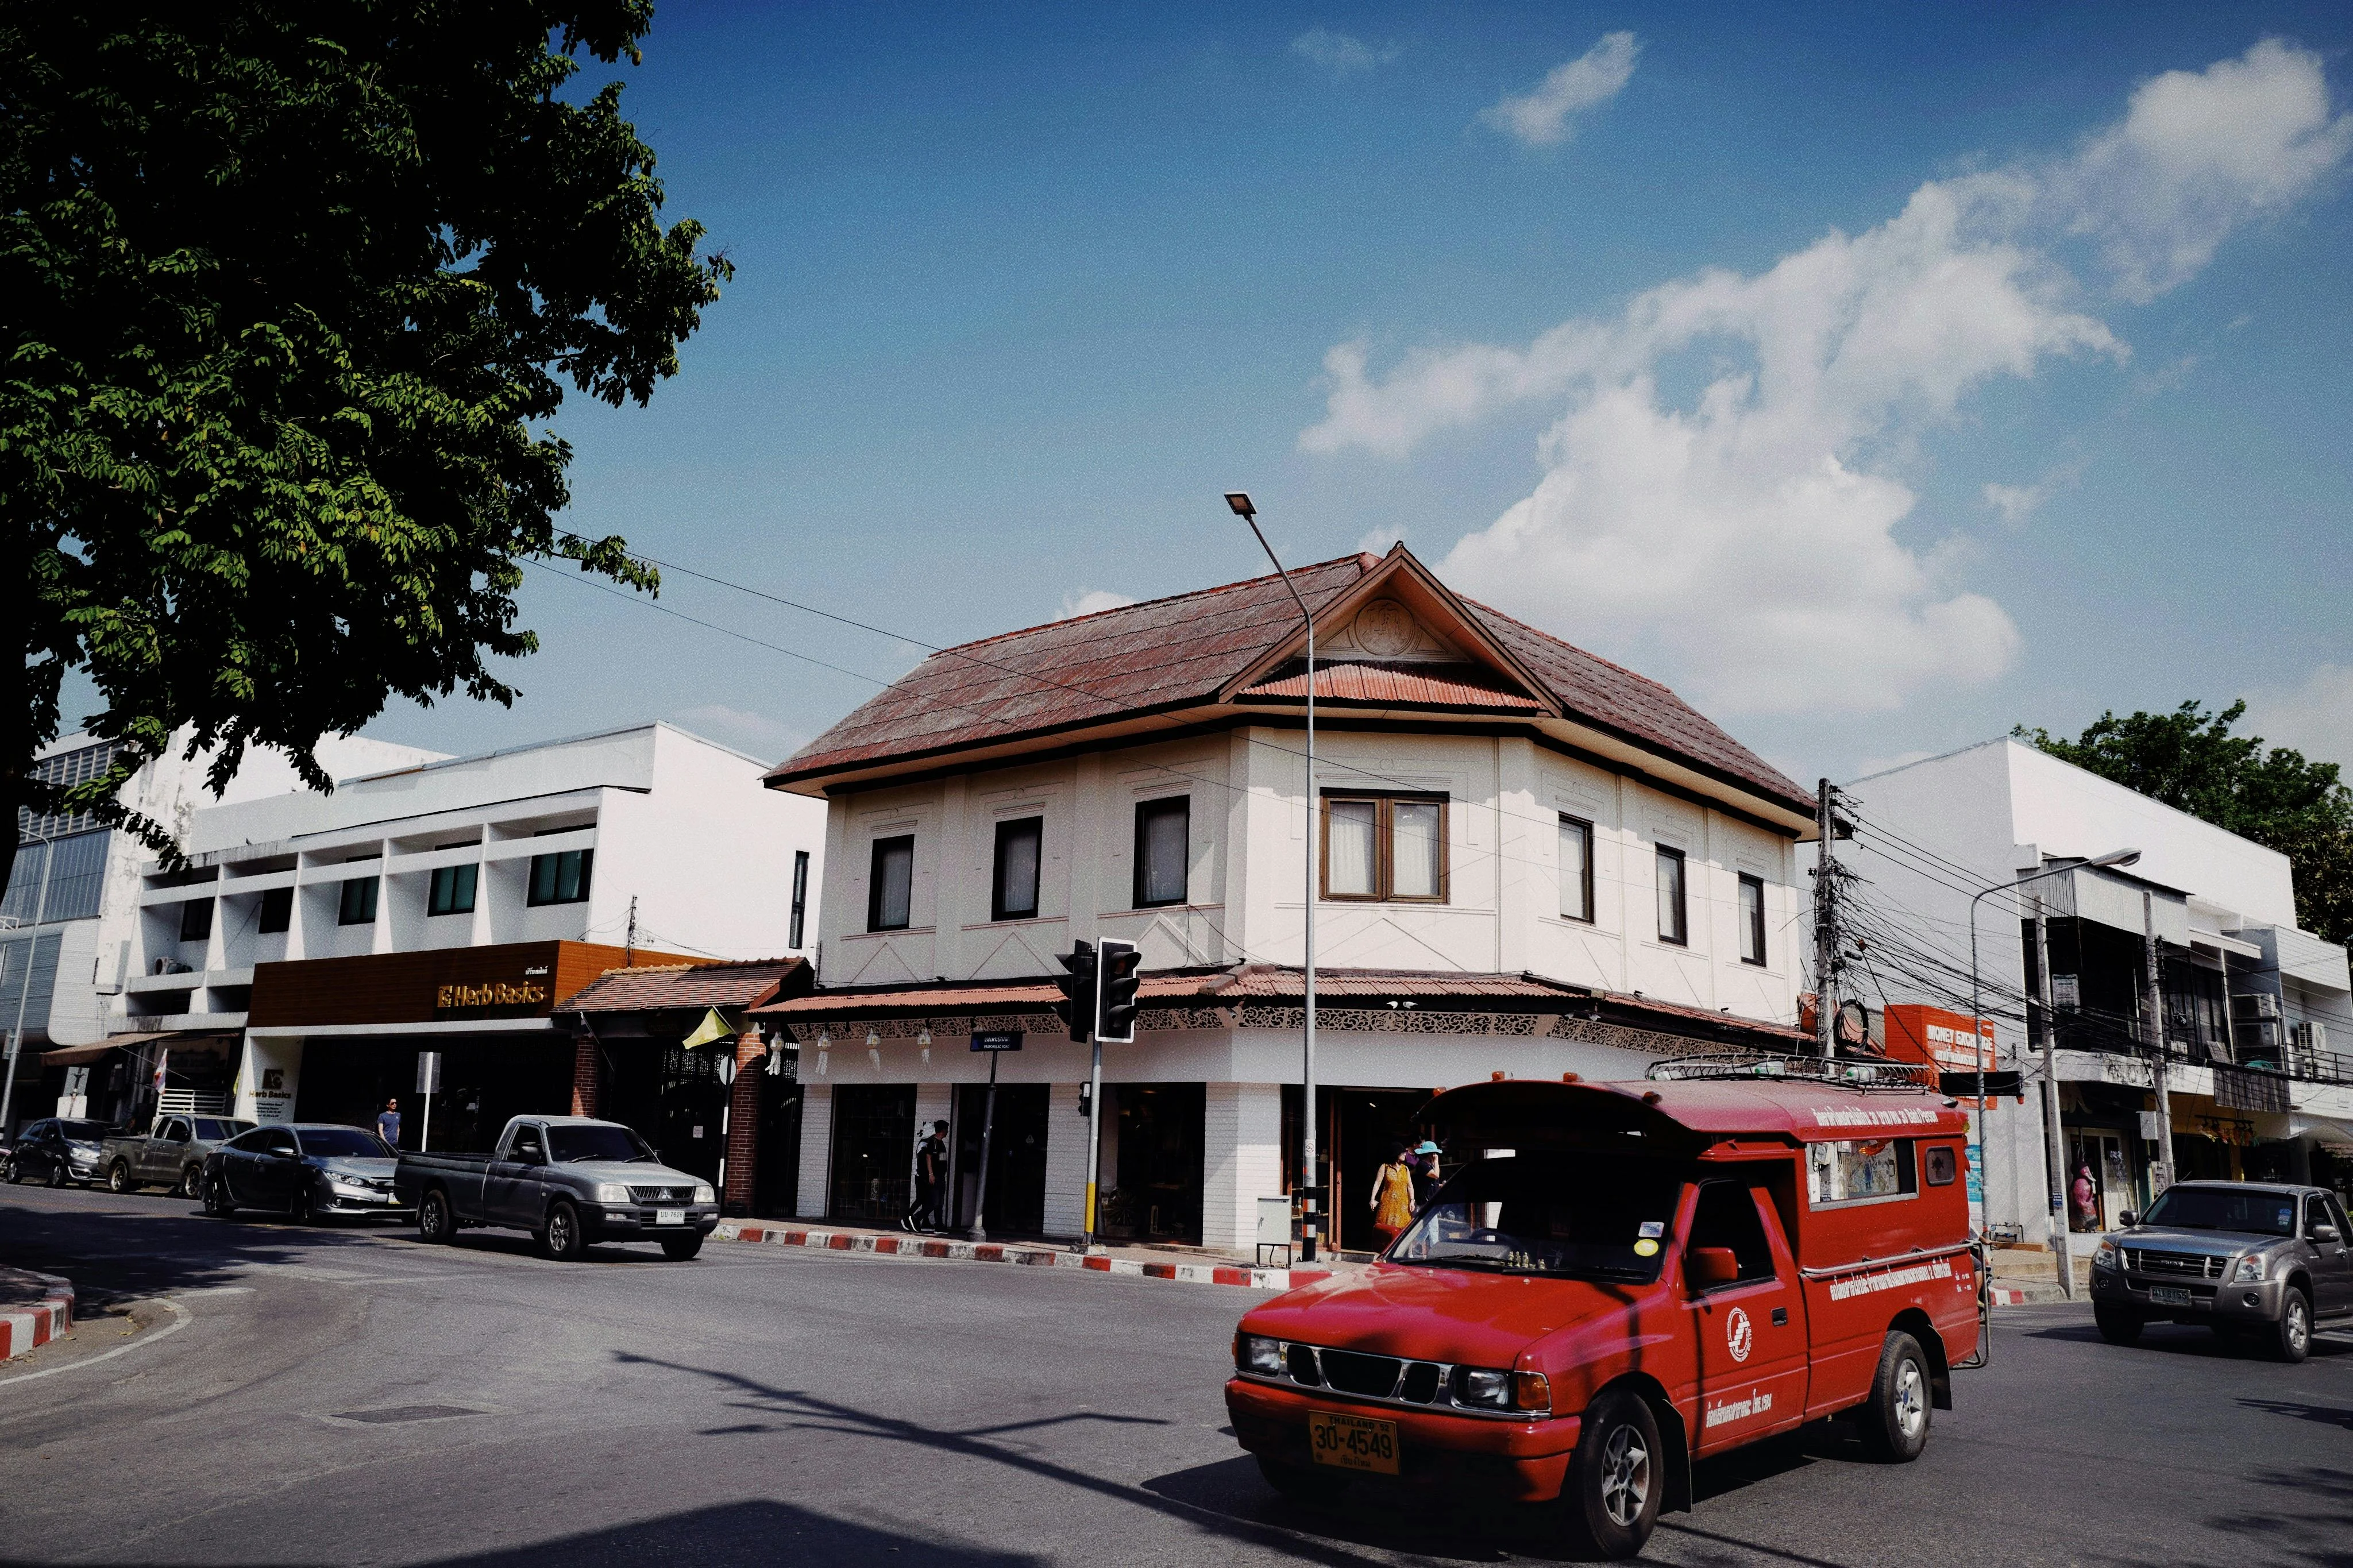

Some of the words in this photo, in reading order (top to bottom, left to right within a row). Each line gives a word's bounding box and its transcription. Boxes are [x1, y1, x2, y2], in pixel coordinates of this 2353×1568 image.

[454, 983, 493, 1007] Herb
[495, 980, 544, 1005] Basics
[1927, 1024, 1954, 1044] MONEY
[1955, 1030, 1993, 1052] EXCHGE
[248, 1090, 267, 1098] Herb
[268, 1091, 291, 1099] Basics
[1928, 1266, 1934, 1280] 2
[1932, 1256, 1953, 1280] เชียงใหม่
[1328, 1416, 1375, 1429] THAILAND
[1380, 1423, 1390, 1432] 52
[1314, 1424, 1392, 1459] 30-4549
[1340, 1454, 1371, 1467] เชียงใหม่
